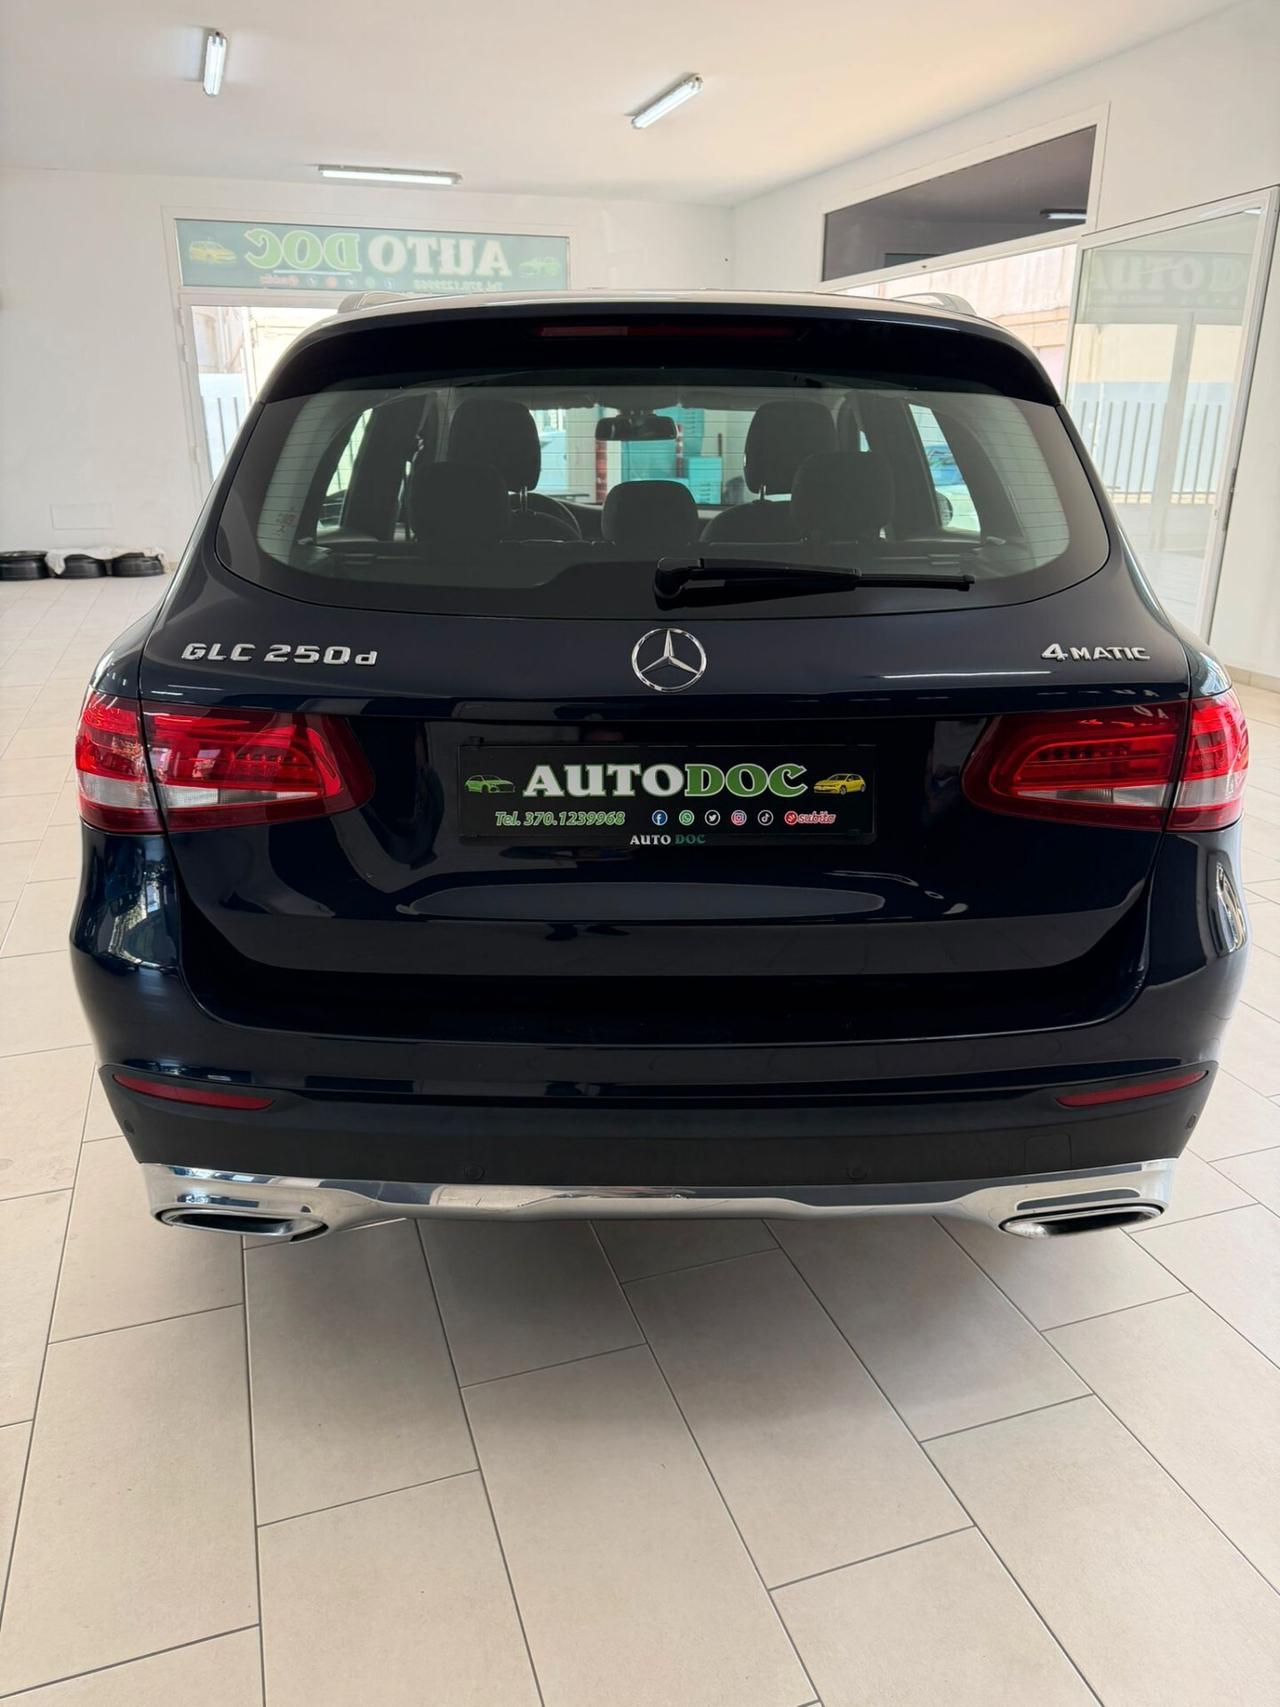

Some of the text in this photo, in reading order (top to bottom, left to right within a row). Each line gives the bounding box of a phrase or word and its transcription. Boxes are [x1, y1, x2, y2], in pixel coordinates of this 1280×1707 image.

[181, 643, 378, 665] GLC 250d
[495, 811, 626, 826] Tel. 370.1239968
[630, 834, 706, 845] AUTO DOC
